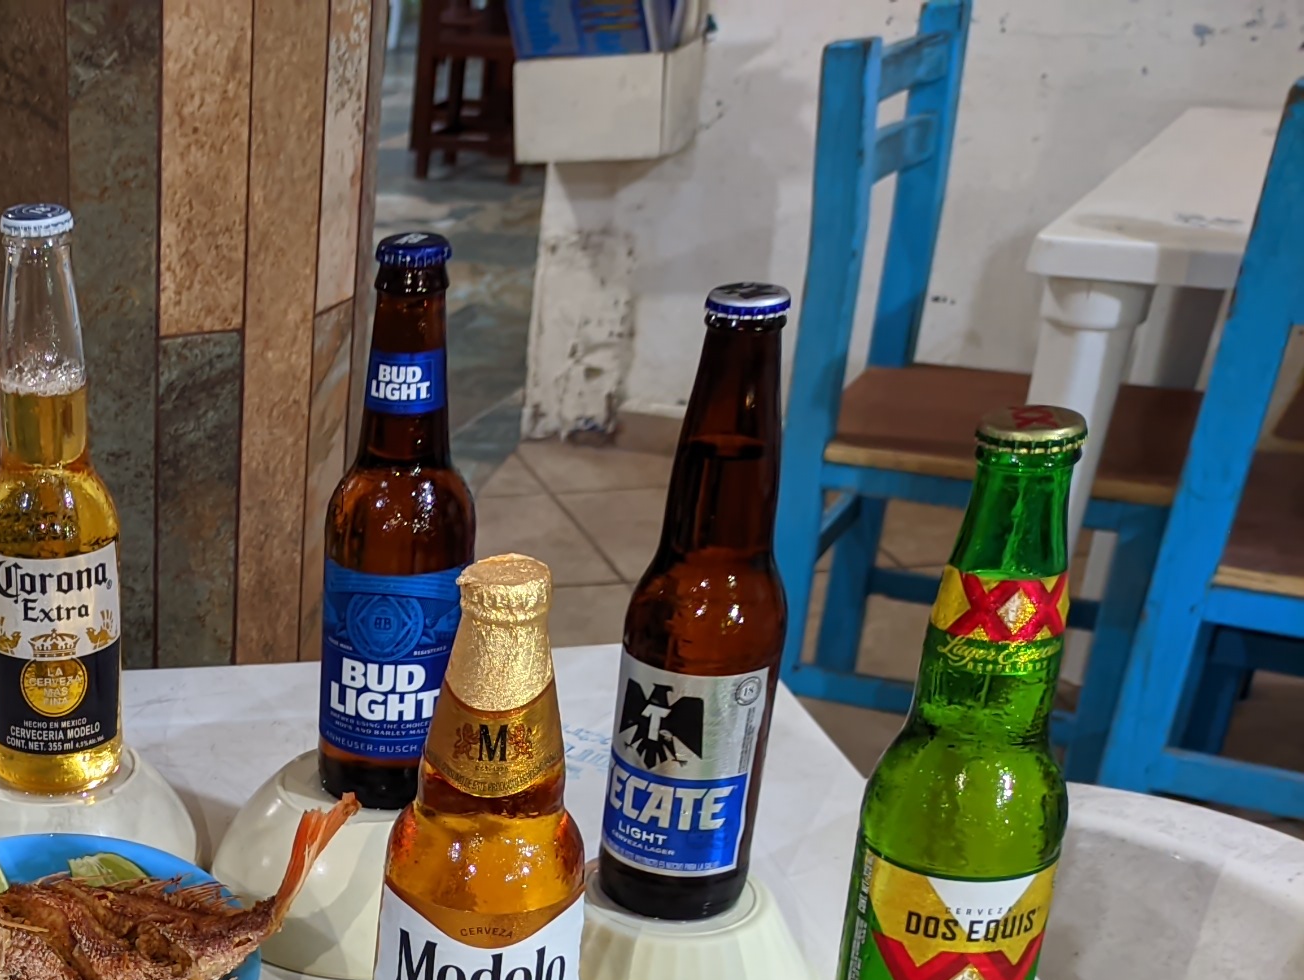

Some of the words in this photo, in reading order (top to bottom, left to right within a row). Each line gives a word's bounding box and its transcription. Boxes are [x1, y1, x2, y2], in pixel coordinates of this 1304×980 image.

[378, 363, 422, 384] BUD
[370, 379, 430, 401] LIGHT
[21, 597, 90, 623] Extra
[47, 667, 63, 677] LA
[341, 657, 426, 692] BUD
[330, 681, 440, 721] LIGHT
[10, 725, 64, 741] CERVECERIA
[67, 721, 101, 739] MODELO
[23, 719, 47, 729] HECHO
[49, 721, 59, 729] EN
[60, 717, 87, 728] MEXICO
[47, 741, 62, 752] 355
[478, 724, 508, 761] M
[608, 765, 733, 831] ECATE
[618, 820, 668, 846] LIGHT
[644, 845, 675, 856] LAGER
[945, 906, 1013, 915] CERVEZA
[460, 927, 513, 938] CERVEZA
[905, 911, 959, 942] DOS
[966, 911, 1037, 943] EQUIS
